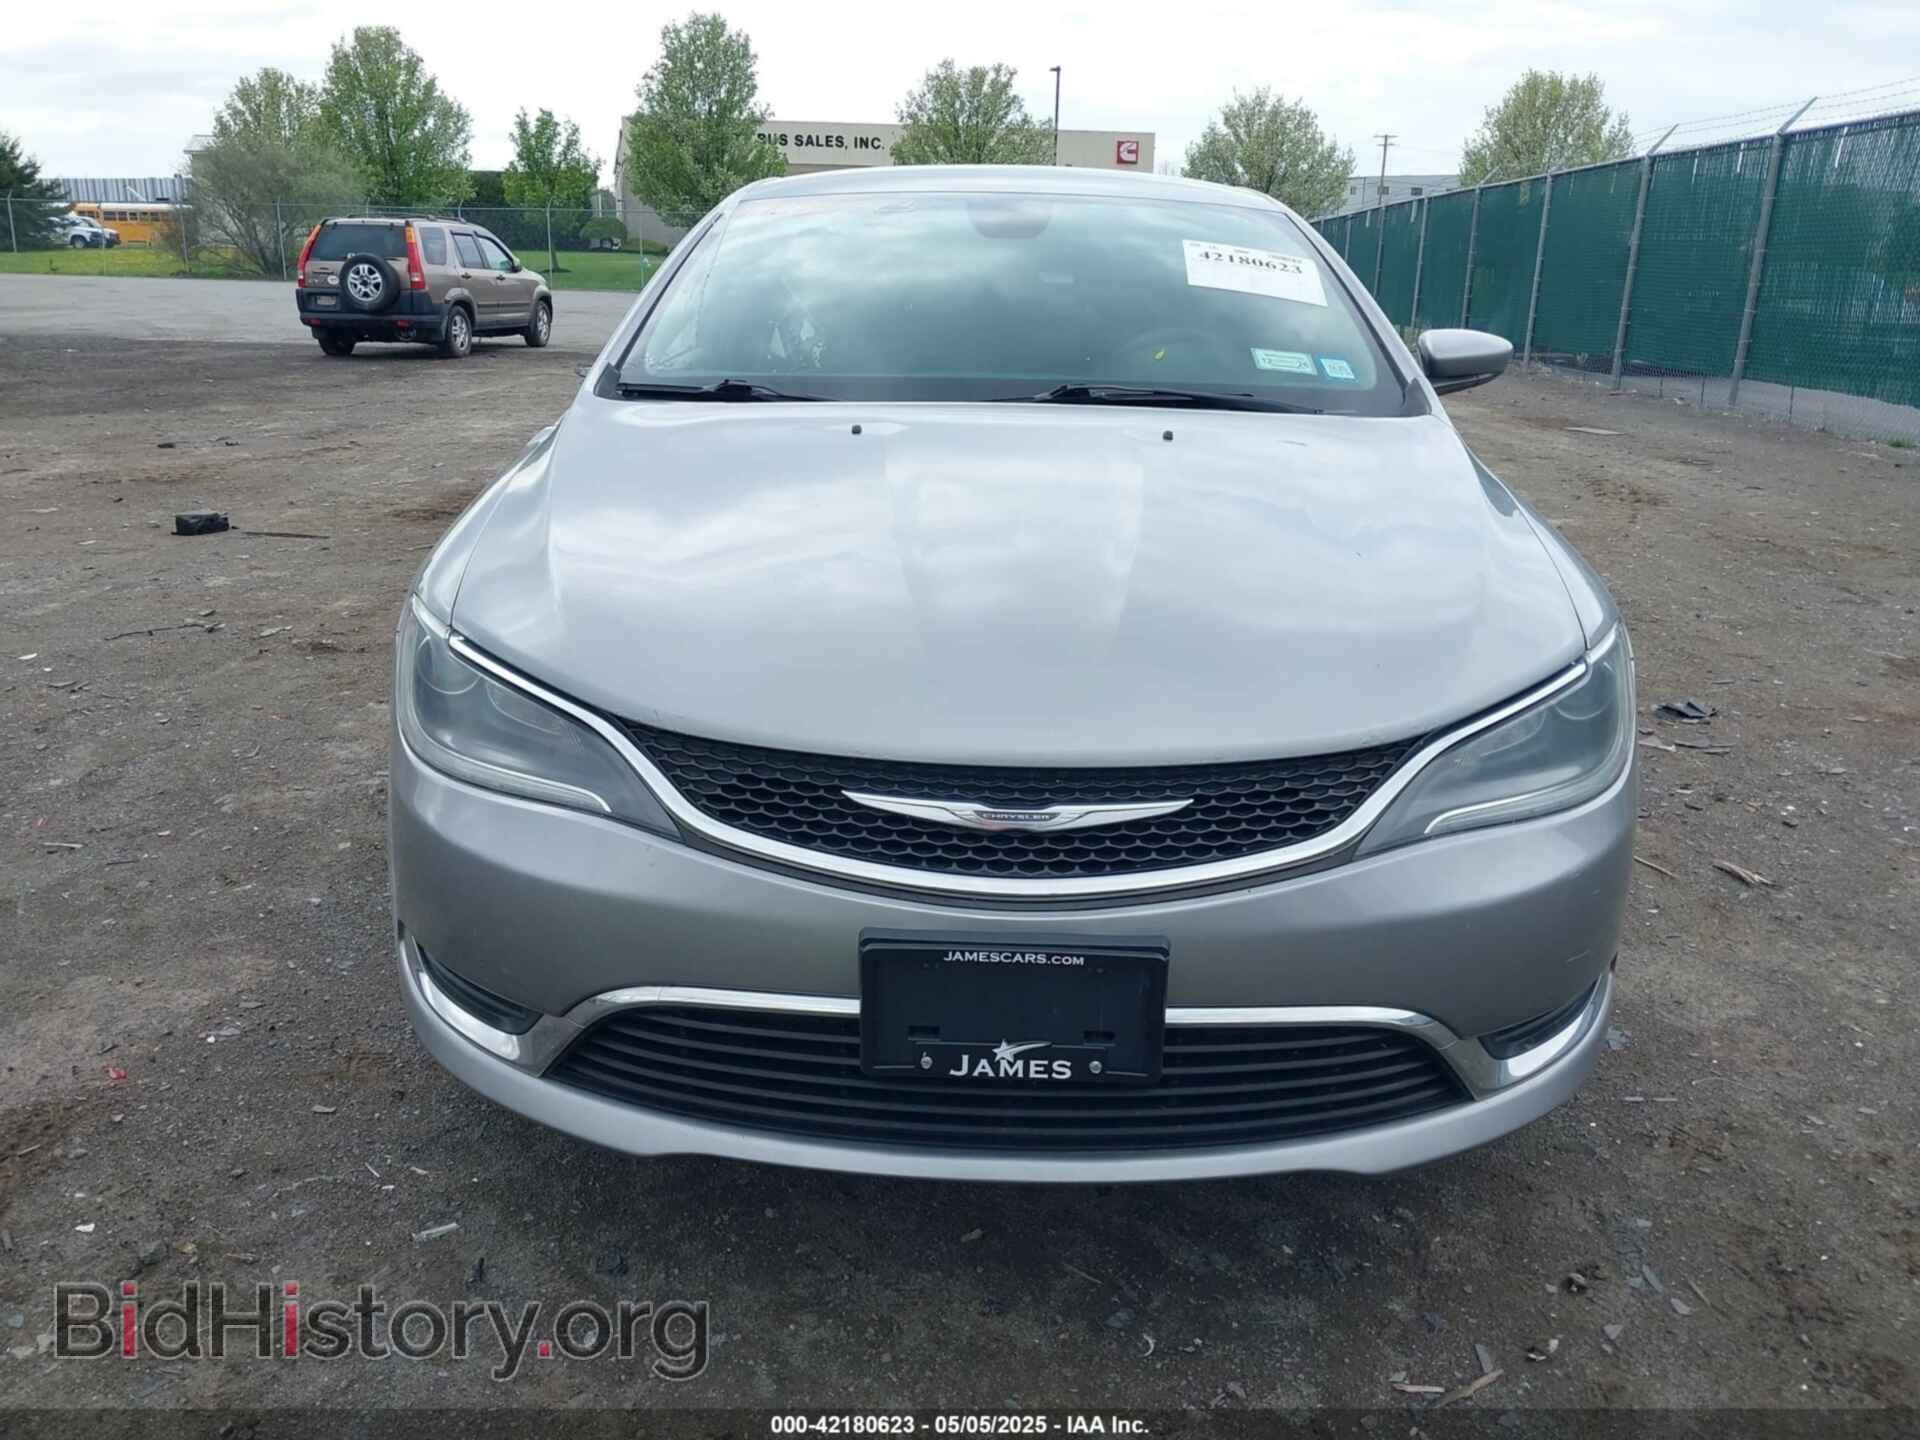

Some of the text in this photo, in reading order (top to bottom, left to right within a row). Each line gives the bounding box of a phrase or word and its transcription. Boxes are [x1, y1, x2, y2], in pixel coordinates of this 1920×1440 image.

[794, 134, 848, 150] SALES,
[854, 136, 885, 149] INC.
[1200, 251, 1303, 274] 42180623
[944, 951, 1085, 966] JAMESCARS.COM
[950, 1054, 1072, 1079] JAMES
